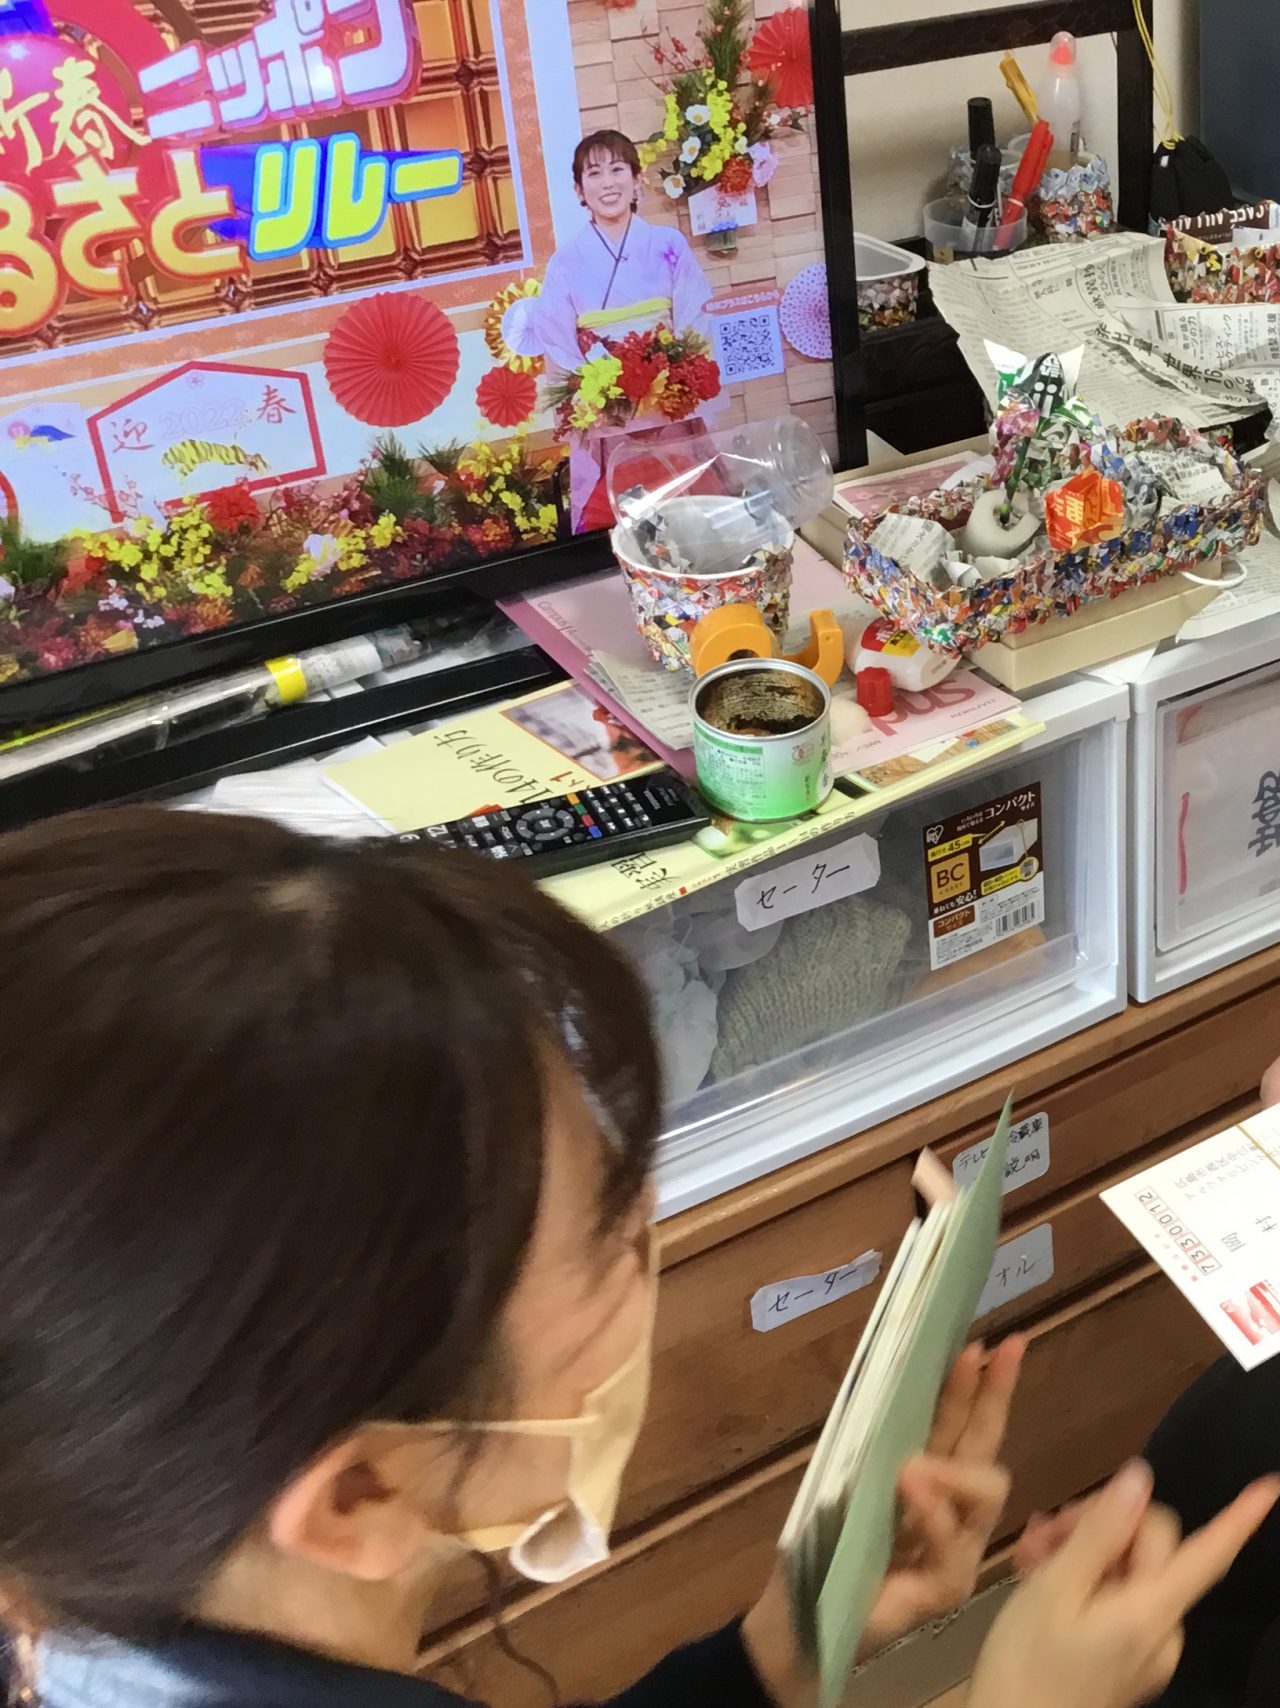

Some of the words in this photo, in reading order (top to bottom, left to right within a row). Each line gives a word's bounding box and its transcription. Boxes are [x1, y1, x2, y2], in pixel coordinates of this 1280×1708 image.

[111, 421, 155, 455] 迎
[256, 384, 297, 425] 春
[985, 791, 1036, 820] コンパクト
[757, 863, 850, 910] セーター
[937, 862, 965, 889] BC
[1137, 1188, 1215, 1276] 7330012
[767, 1268, 858, 1314] セーター
